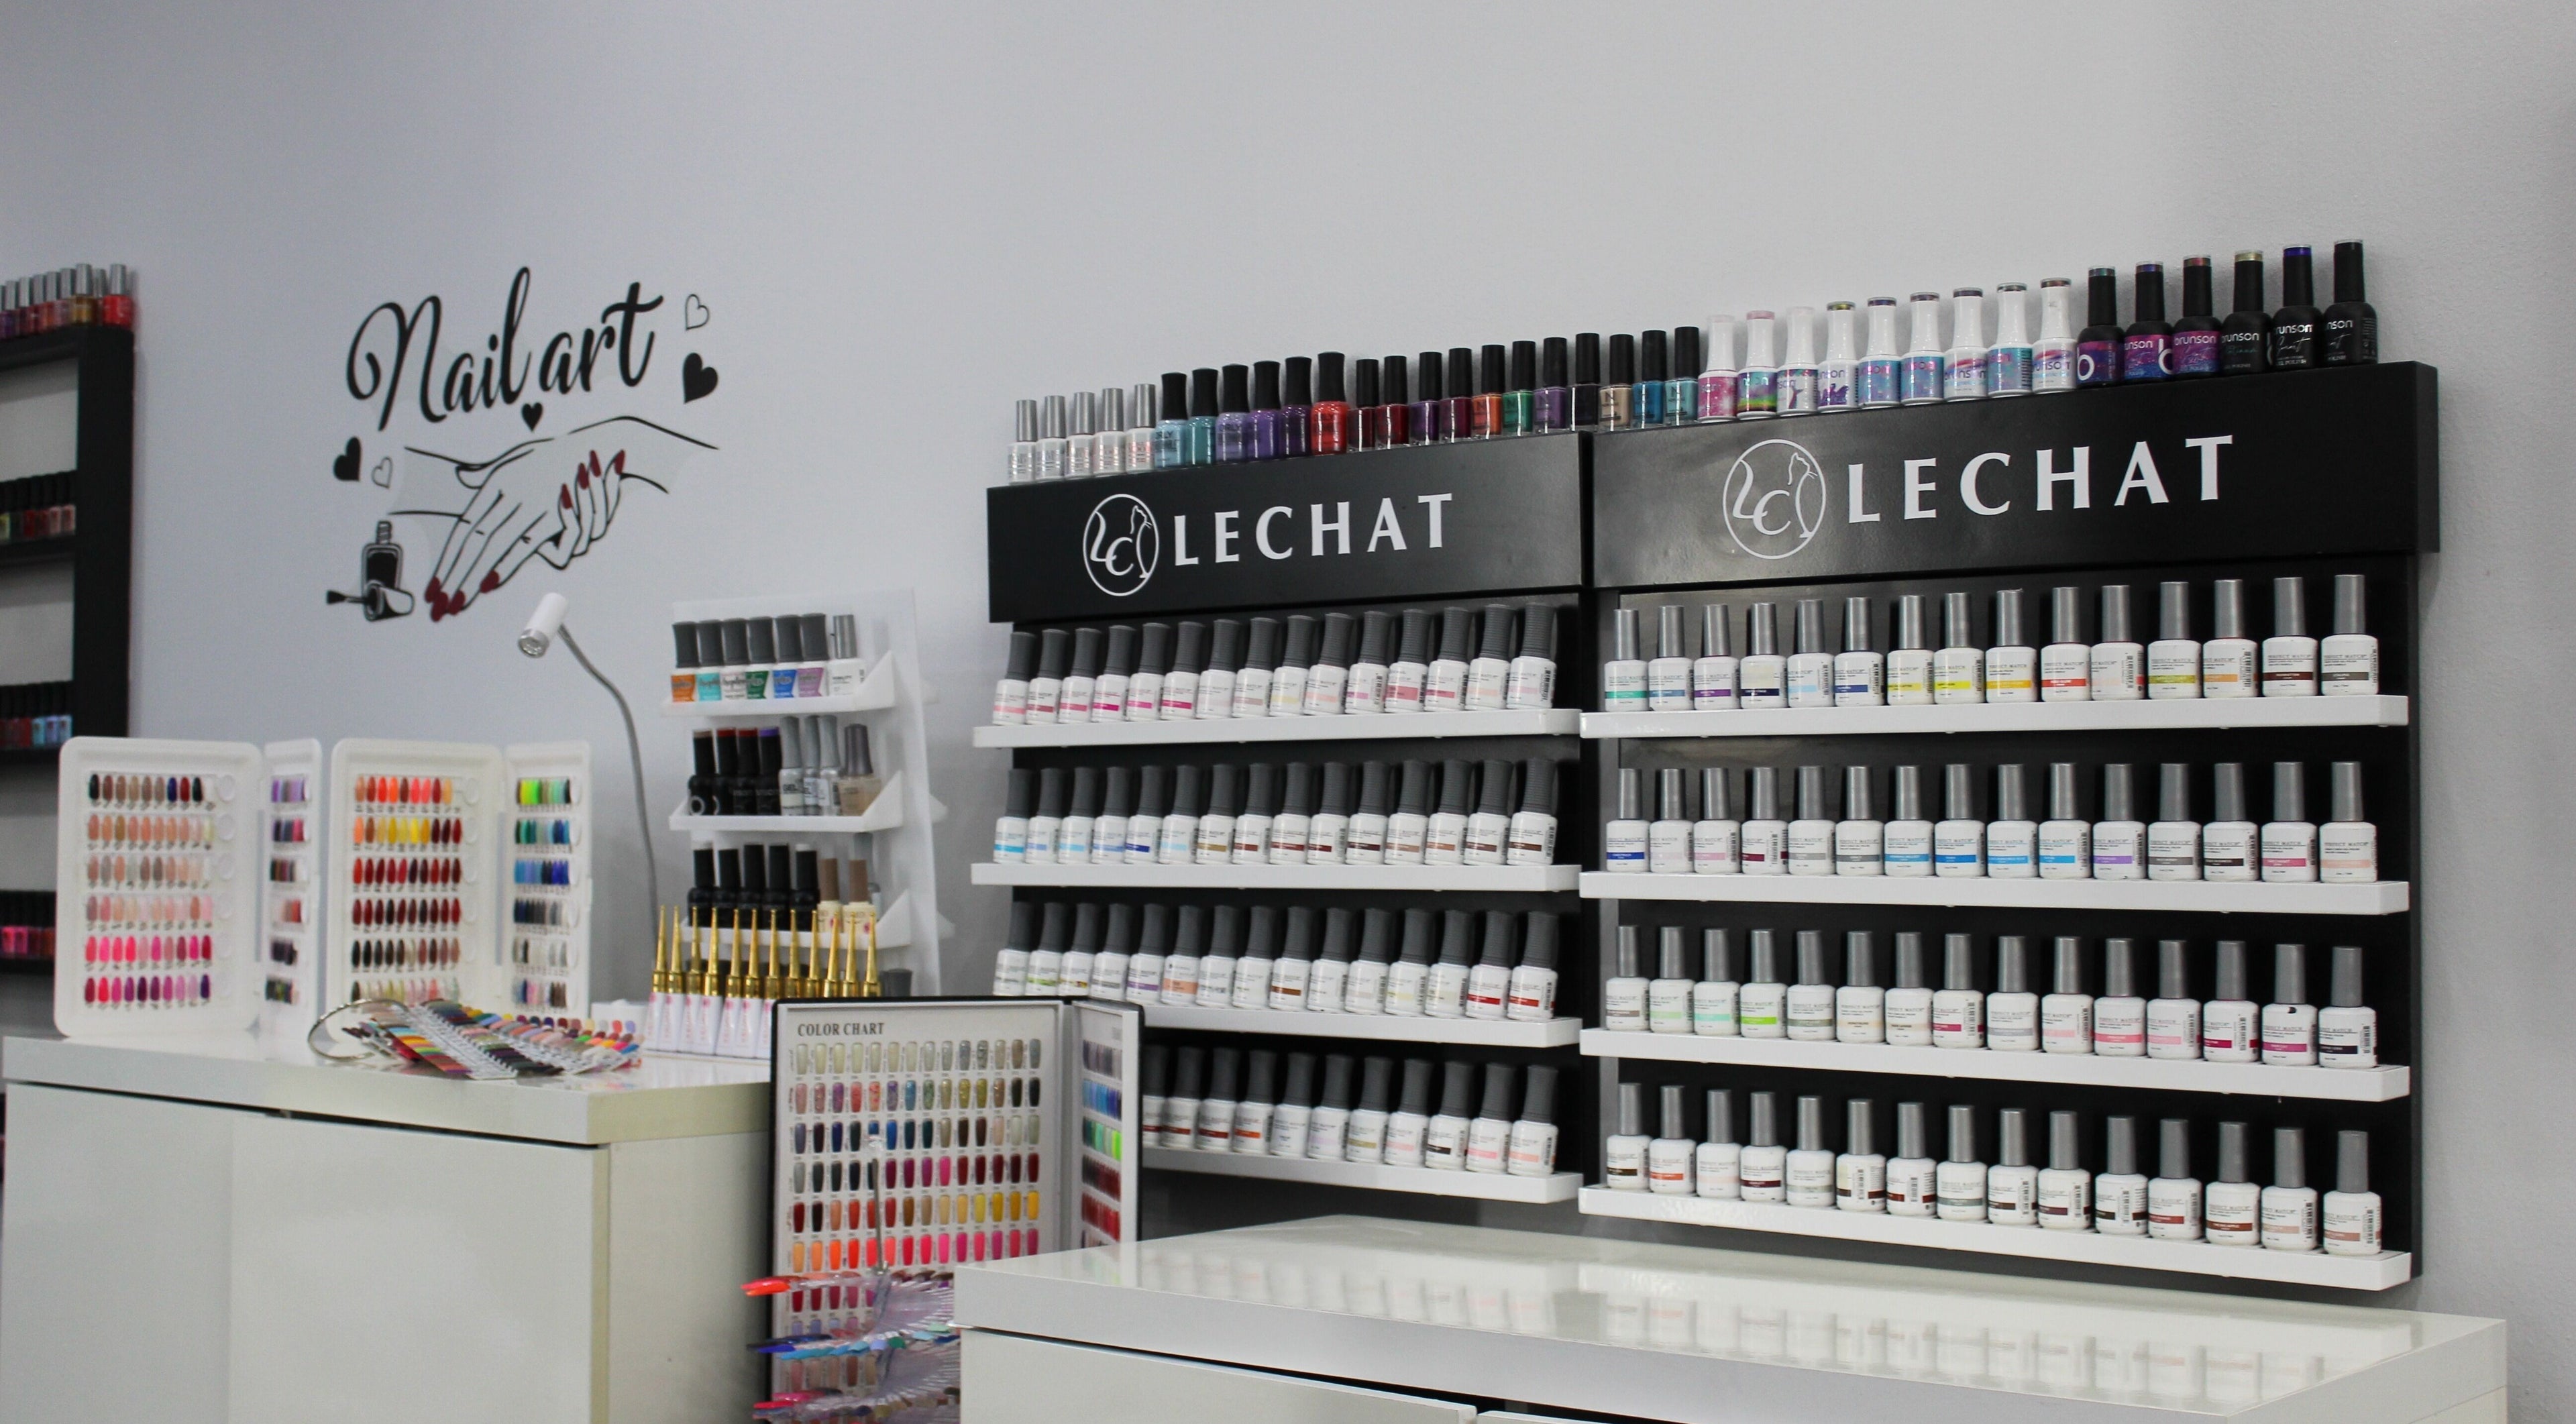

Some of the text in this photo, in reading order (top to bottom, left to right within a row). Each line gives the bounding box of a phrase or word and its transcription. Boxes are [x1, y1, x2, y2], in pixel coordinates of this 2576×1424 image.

[346, 266, 663, 431] Nail art
[1847, 435, 2233, 525] LECHAT
[1173, 492, 1453, 567] LECHAT
[797, 1022, 885, 1037] COLOR CHART
